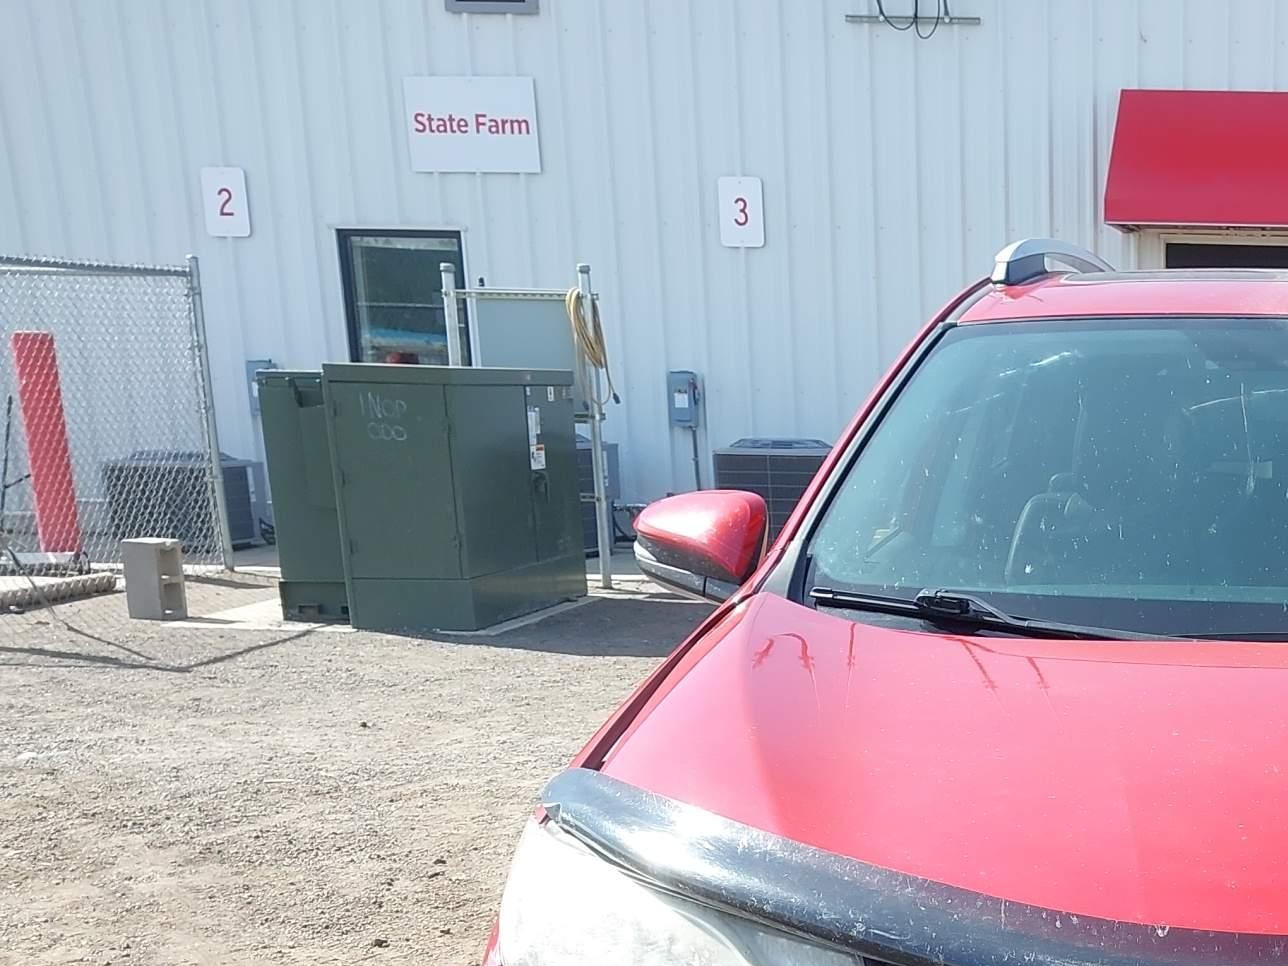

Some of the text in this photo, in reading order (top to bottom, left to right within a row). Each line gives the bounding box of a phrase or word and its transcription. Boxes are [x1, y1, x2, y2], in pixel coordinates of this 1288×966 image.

[414, 113, 531, 135] State Farm
[217, 187, 235, 217] 2
[734, 197, 749, 226] 3
